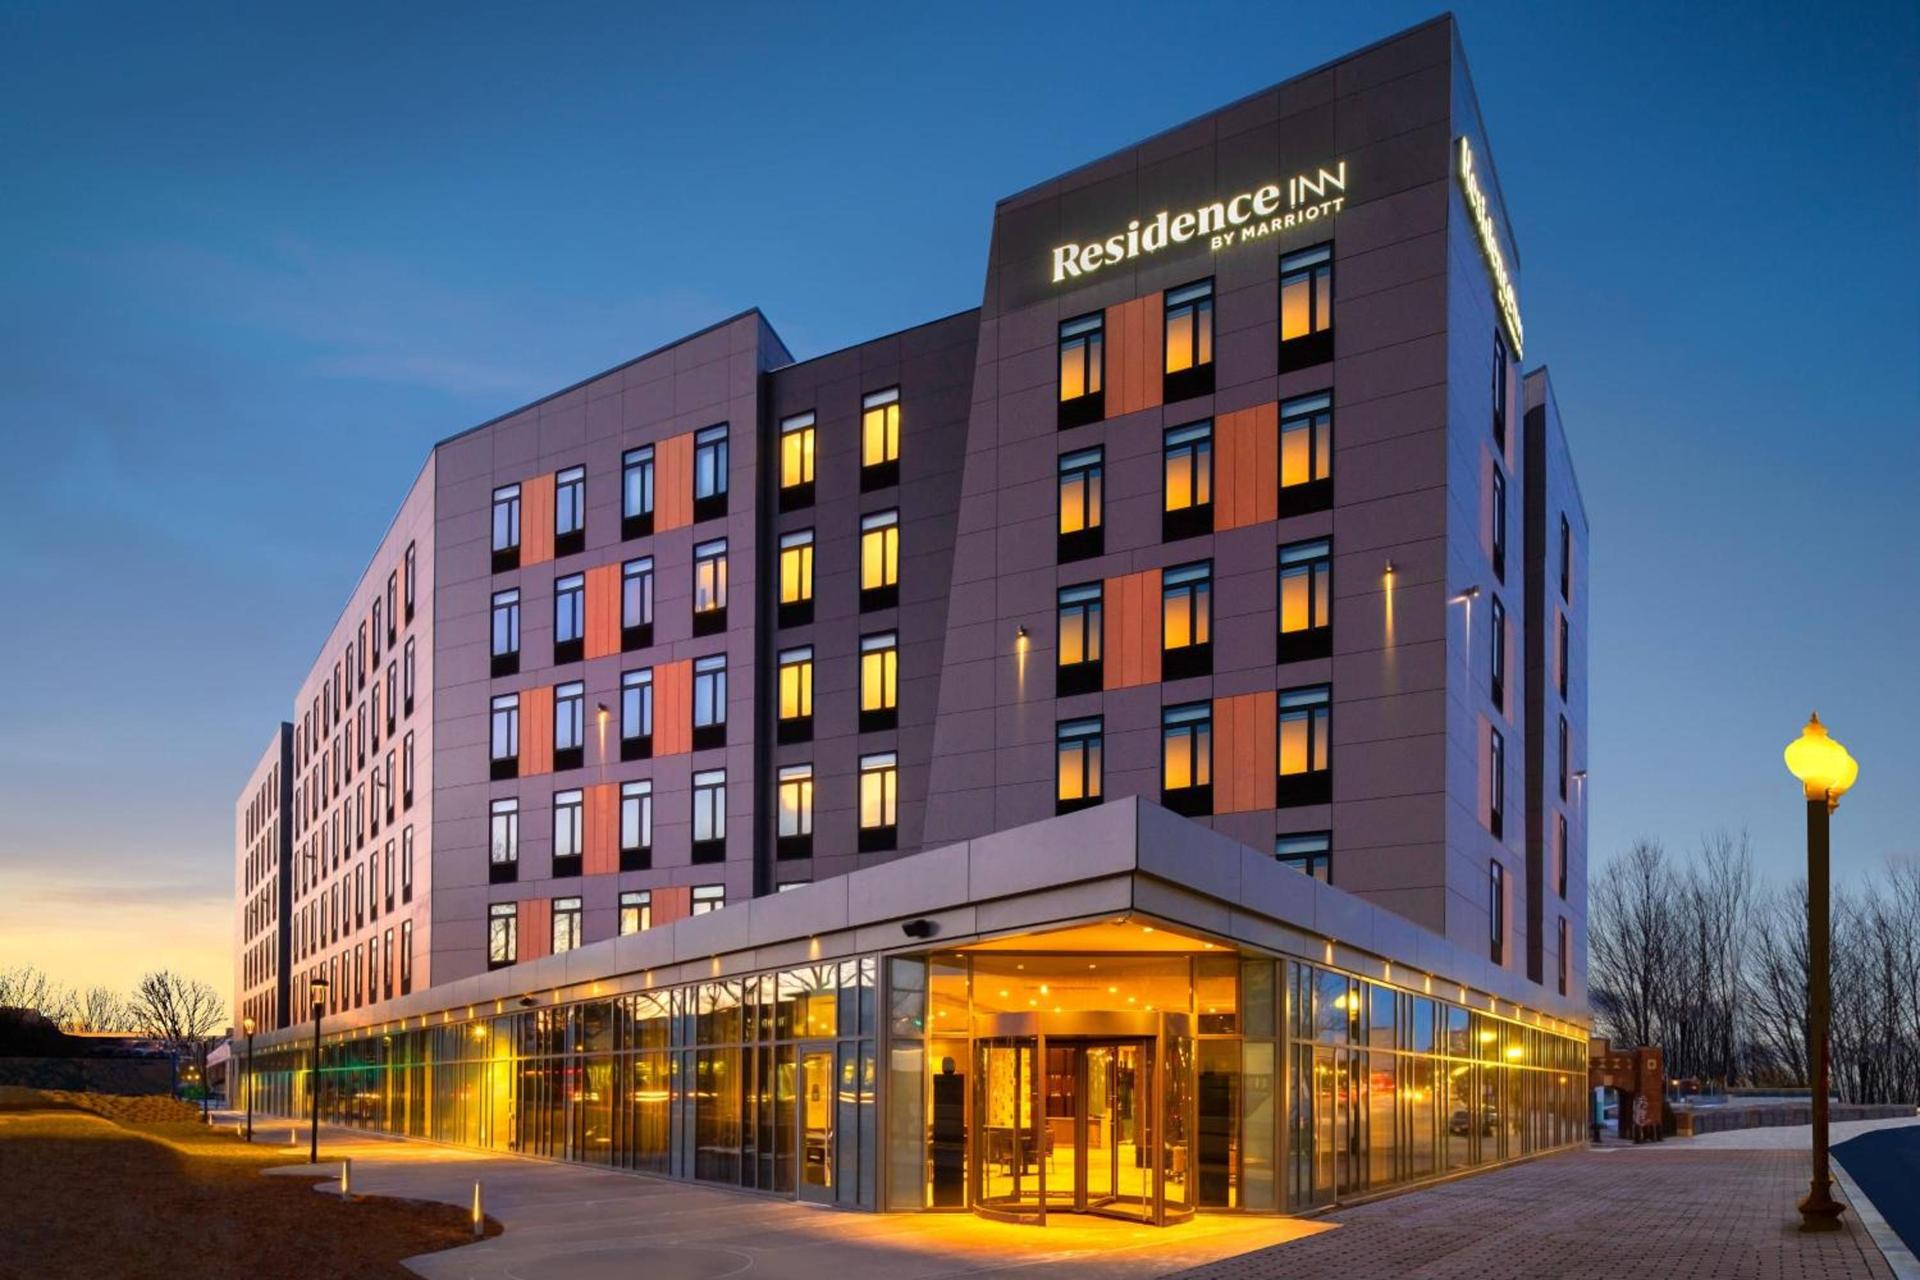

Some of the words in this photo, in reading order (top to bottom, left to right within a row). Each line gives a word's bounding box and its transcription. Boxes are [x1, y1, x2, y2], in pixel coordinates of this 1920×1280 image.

[1051, 183, 1280, 283] Residence
[1289, 161, 1346, 208] INN
[1210, 231, 1235, 251] BY
[1241, 197, 1345, 242] MARRIOTT
